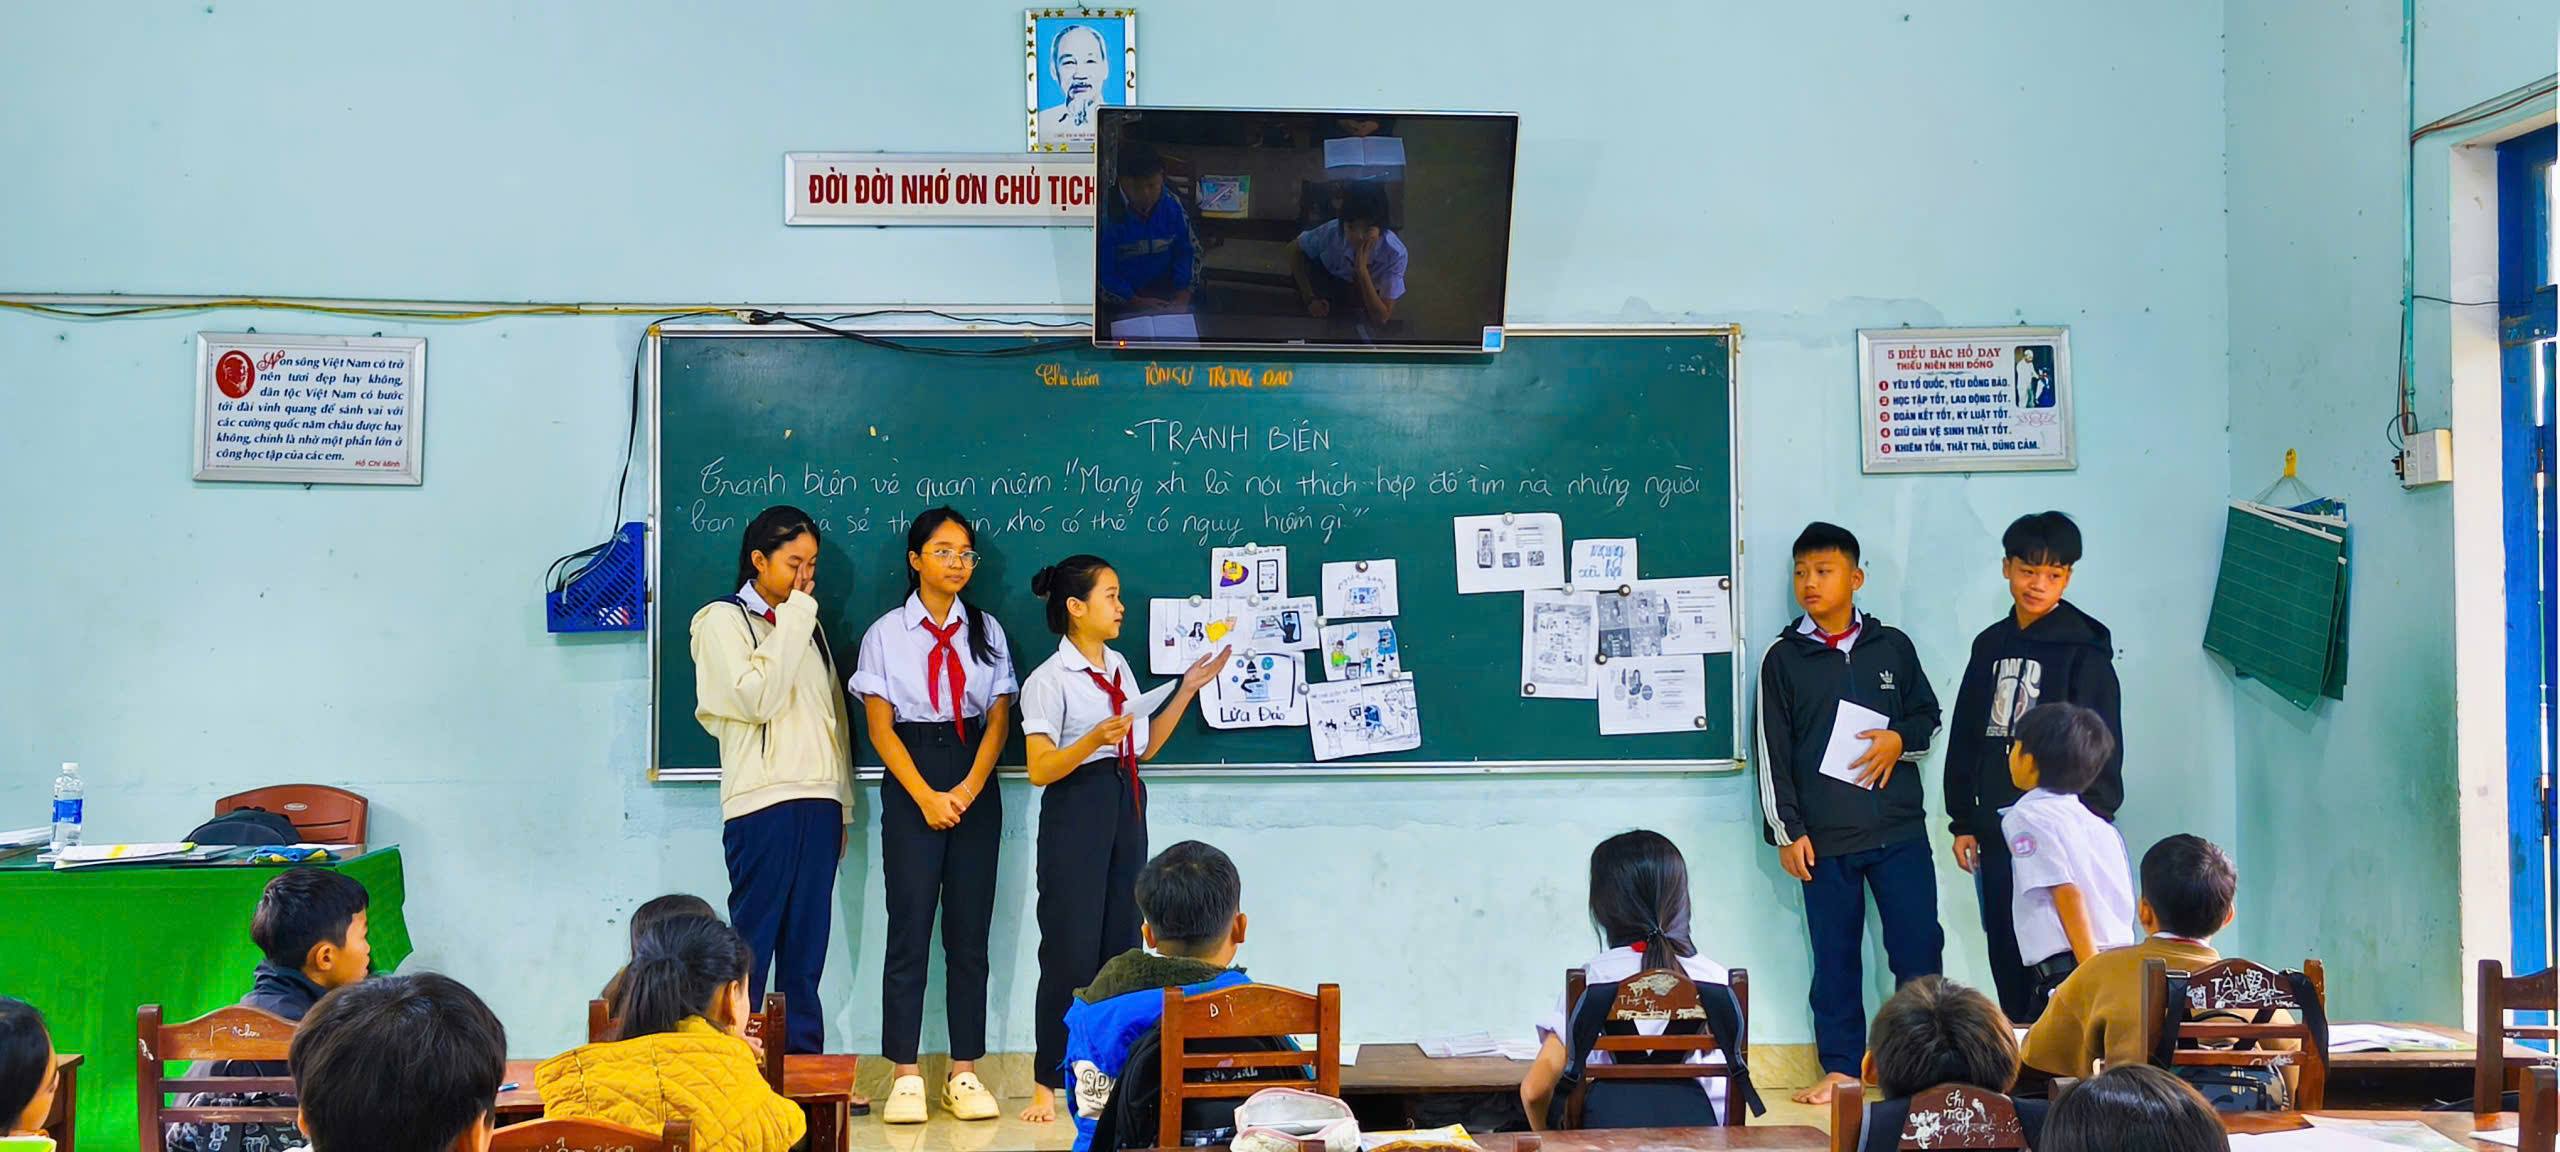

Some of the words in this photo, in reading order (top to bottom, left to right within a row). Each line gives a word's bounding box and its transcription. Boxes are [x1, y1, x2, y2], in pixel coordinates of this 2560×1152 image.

[809, 167, 847, 204] ĐỜI
[855, 167, 893, 204] ĐỜI
[902, 168, 951, 204] NHỚ
[956, 173, 987, 204] ƠN
[995, 165, 1040, 204] CHỦ
[1048, 175, 1095, 210] TỊCH
[1888, 350, 1894, 359] 5
[1978, 348, 2001, 359] DẠY
[296, 357, 320, 369] sông
[323, 358, 344, 369] Việt
[346, 358, 370, 368] Nam
[374, 359, 386, 368] có
[260, 372, 280, 381] nên
[288, 372, 310, 382] tươi
[343, 373, 361, 386] hay
[368, 374, 402, 387] không,
[260, 387, 280, 397] dân
[284, 388, 301, 399] tộc
[306, 388, 328, 400] Việt
[332, 390, 356, 398] Nam
[361, 390, 373, 399] có
[377, 390, 404, 400] bước
[1951, 396, 1966, 404] LAO
[218, 401, 233, 411] tới
[258, 403, 280, 412] vinh
[285, 406, 316, 416] quang
[339, 404, 363, 414] sánh
[368, 406, 384, 415] vai
[387, 406, 404, 416] với
[218, 418, 236, 427] các
[238, 418, 271, 430] cường
[274, 418, 300, 430] quốc
[302, 420, 325, 429] năm
[328, 420, 353, 430] châu
[384, 421, 402, 432] hay
[1944, 427, 1964, 436] SINH
[216, 432, 251, 445] không,
[254, 434, 283, 443] chính
[286, 434, 295, 444] là
[298, 434, 319, 444] nhờ
[322, 436, 342, 447] một
[375, 436, 392, 446] lớn
[1134, 418, 1248, 454] TRANH
[216, 448, 242, 460] công
[244, 448, 264, 460] học
[266, 449, 282, 462] tập
[285, 450, 303, 460] của
[306, 451, 324, 460] các
[916, 477, 976, 505] quan
[1206, 468, 1234, 494] là
[1062, 508, 1084, 533] có
[1146, 506, 1171, 532] có
[1182, 514, 1244, 546] nguy
